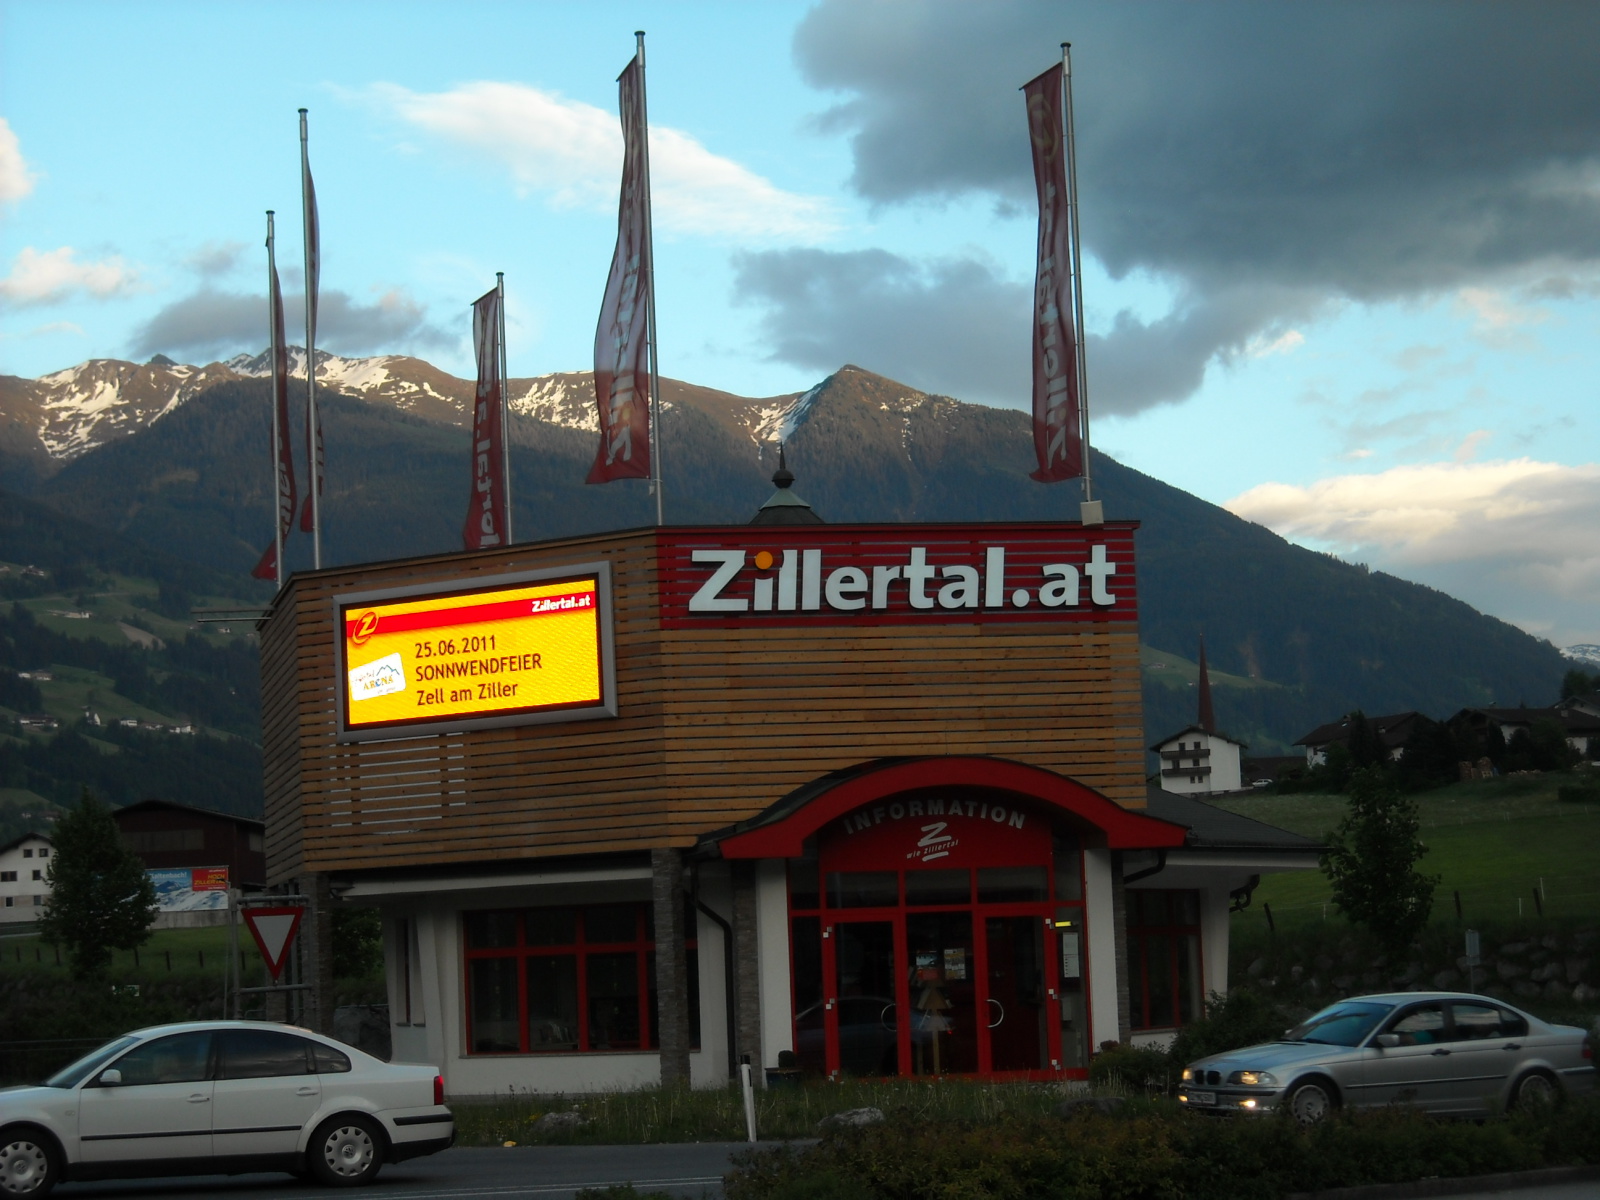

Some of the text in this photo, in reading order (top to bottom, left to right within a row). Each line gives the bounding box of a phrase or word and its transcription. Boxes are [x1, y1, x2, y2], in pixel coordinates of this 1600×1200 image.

[688, 544, 1116, 612] Zillertal.at
[531, 594, 591, 613] Zillertal.at
[415, 634, 496, 658] 25.06.2011
[415, 653, 542, 682] SONNWENDFEIER
[417, 688, 444, 706] Zell
[450, 687, 472, 702] am
[478, 682, 518, 700] Ziller
[843, 799, 1026, 834] INFORMATION
